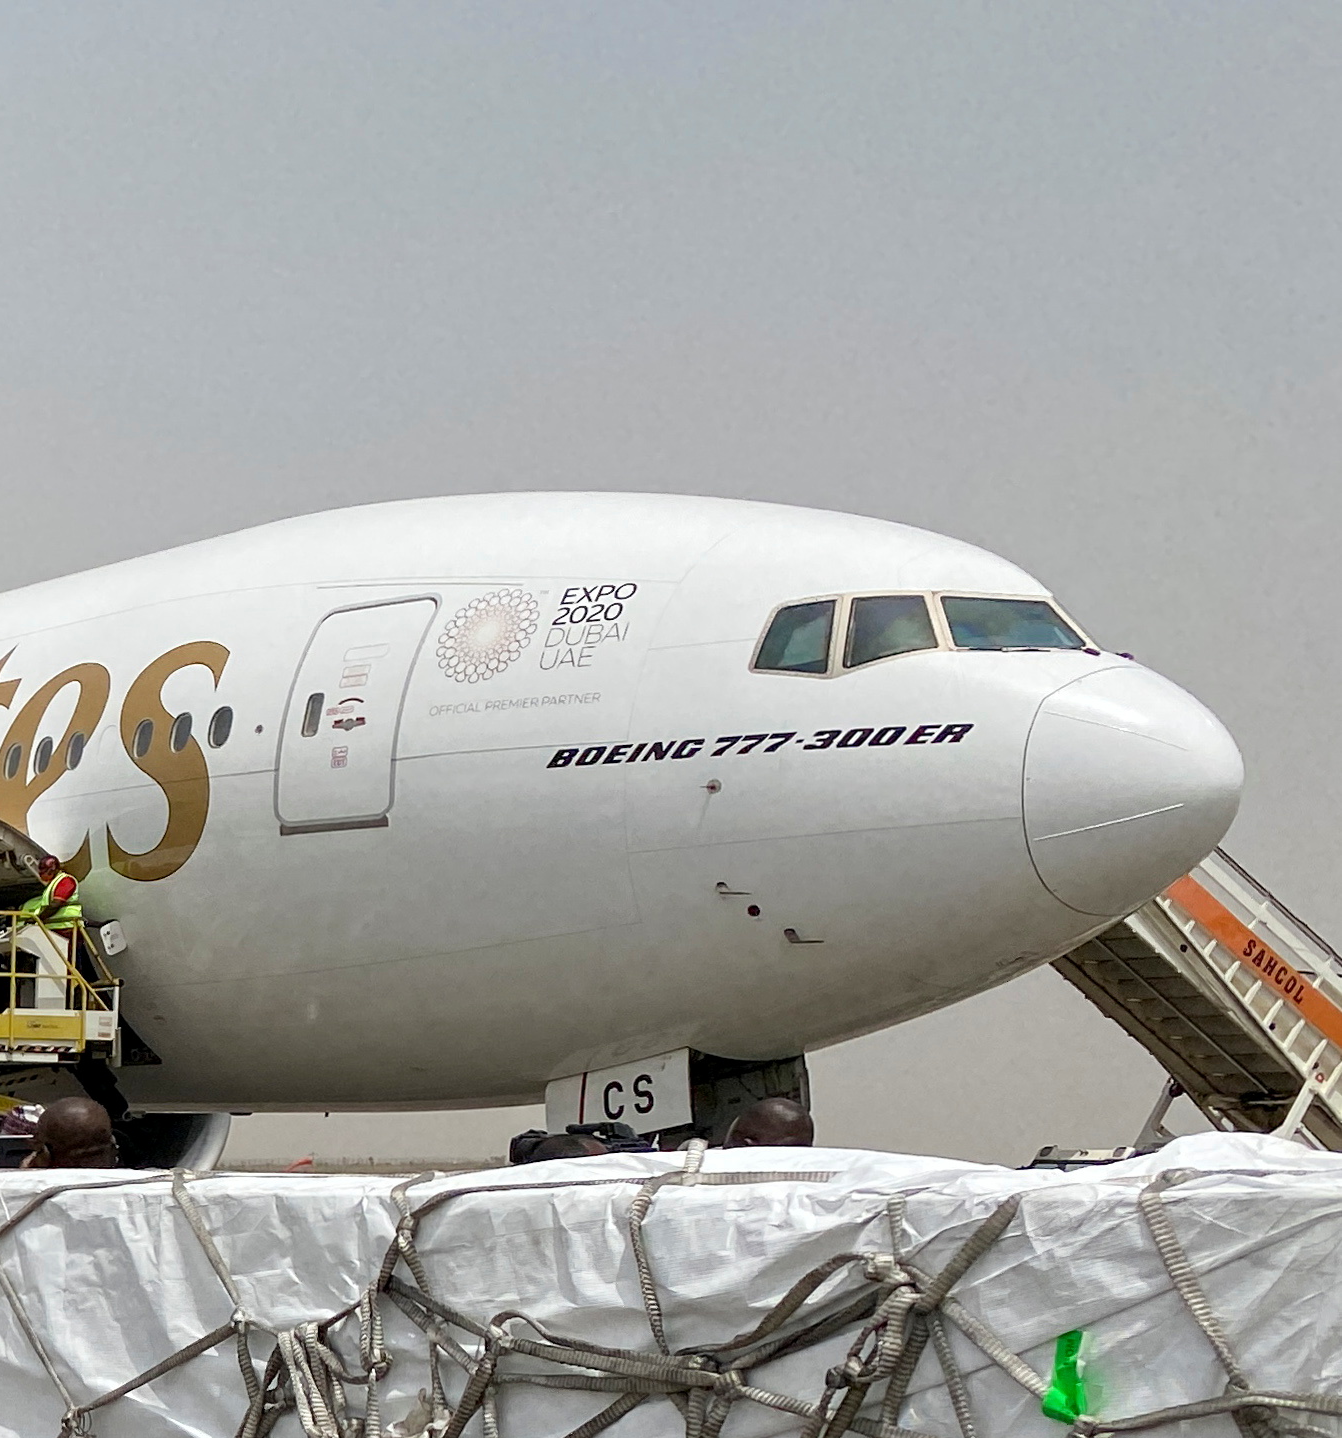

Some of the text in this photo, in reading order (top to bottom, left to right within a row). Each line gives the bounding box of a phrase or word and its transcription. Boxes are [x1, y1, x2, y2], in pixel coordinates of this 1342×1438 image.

[559, 582, 638, 606] EXPO
[551, 602, 624, 626] 2020
[544, 621, 631, 648] DUBAI
[539, 645, 597, 671] UAE
[428, 691, 603, 718] OFFICIAL PREMIER PARTNER
[545, 738, 706, 769] BOEING
[1242, 938, 1306, 1006] SAHCOL
[603, 1073, 655, 1120] CS
